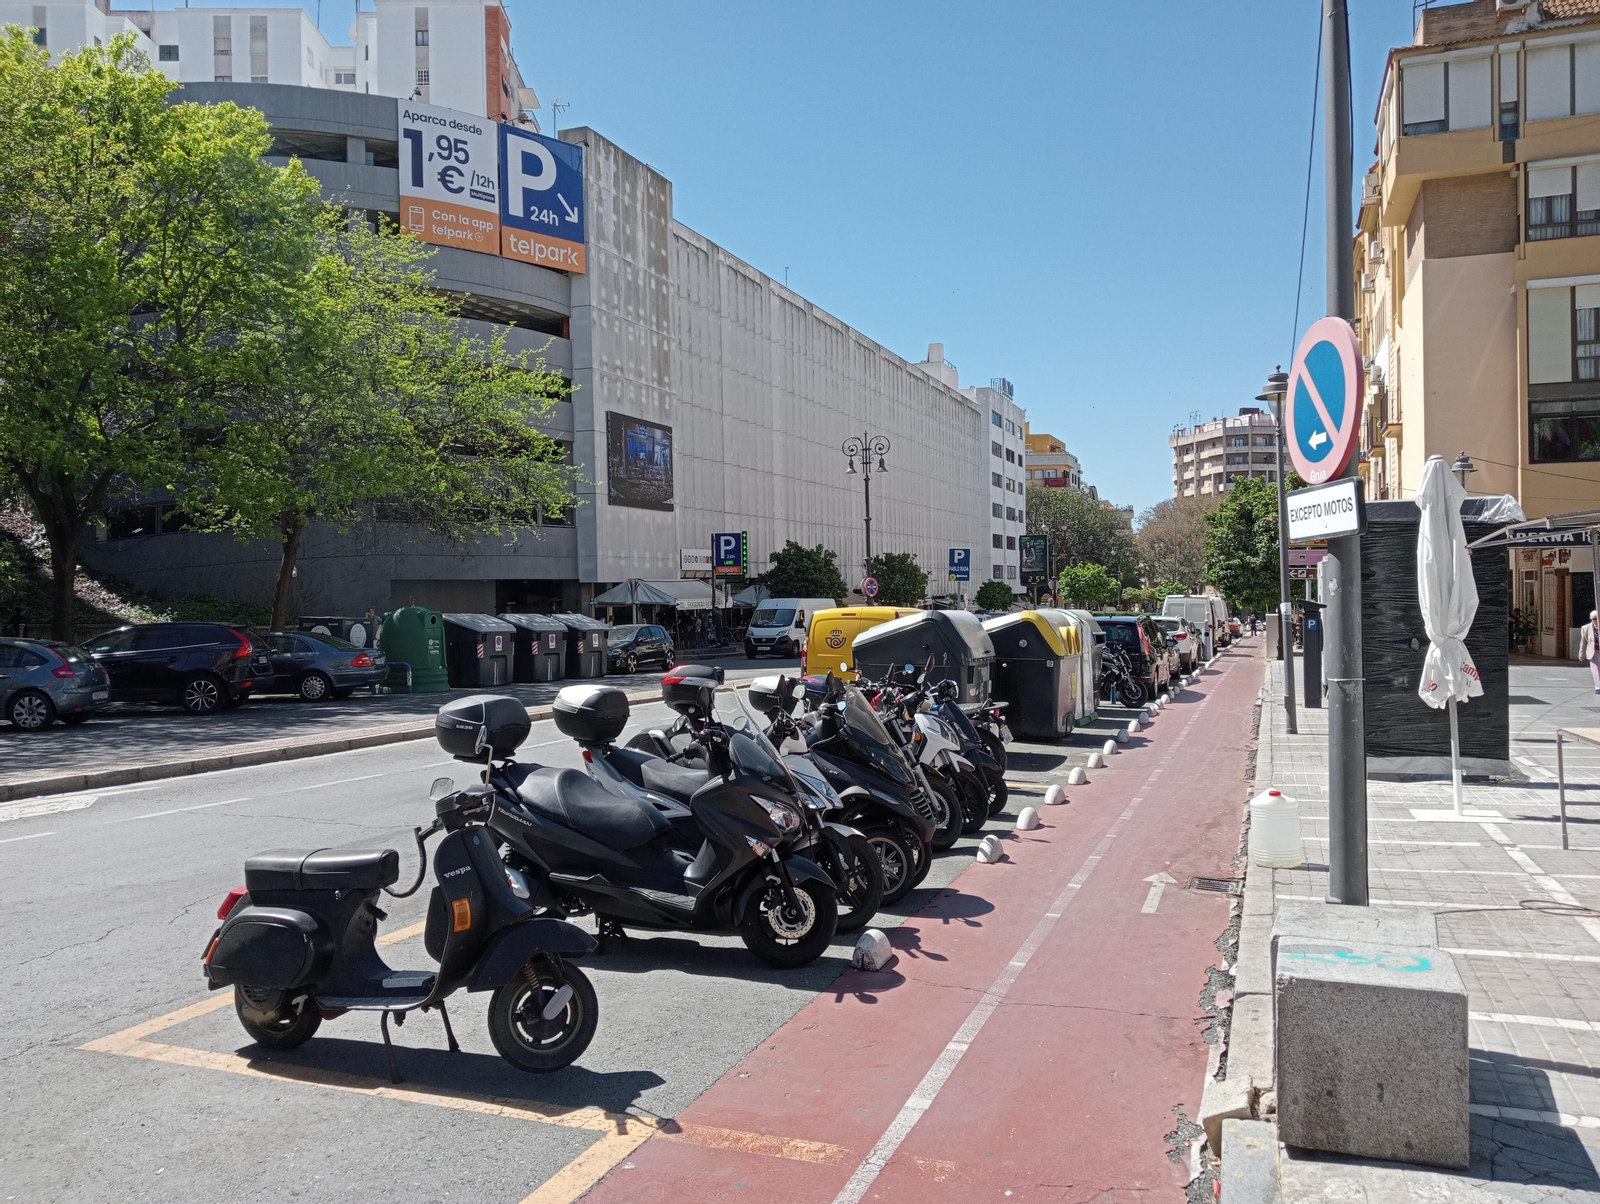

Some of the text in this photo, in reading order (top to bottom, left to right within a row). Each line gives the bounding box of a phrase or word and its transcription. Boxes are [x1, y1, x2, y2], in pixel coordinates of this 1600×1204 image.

[402, 109, 483, 136] Aparca desde
[402, 128, 470, 188] 1,95
[437, 165, 495, 194] € /12h
[506, 132, 557, 218] P
[431, 209, 494, 233] Con la app
[530, 205, 559, 227] 24h
[431, 224, 474, 241] telpark
[509, 233, 579, 266] telpark
[1290, 496, 1354, 523] EXCEPTO MOTOS
[720, 536, 736, 559] P
[954, 549, 965, 564] P
[1308, 619, 1316, 629] P
[443, 865, 472, 879] vespa
